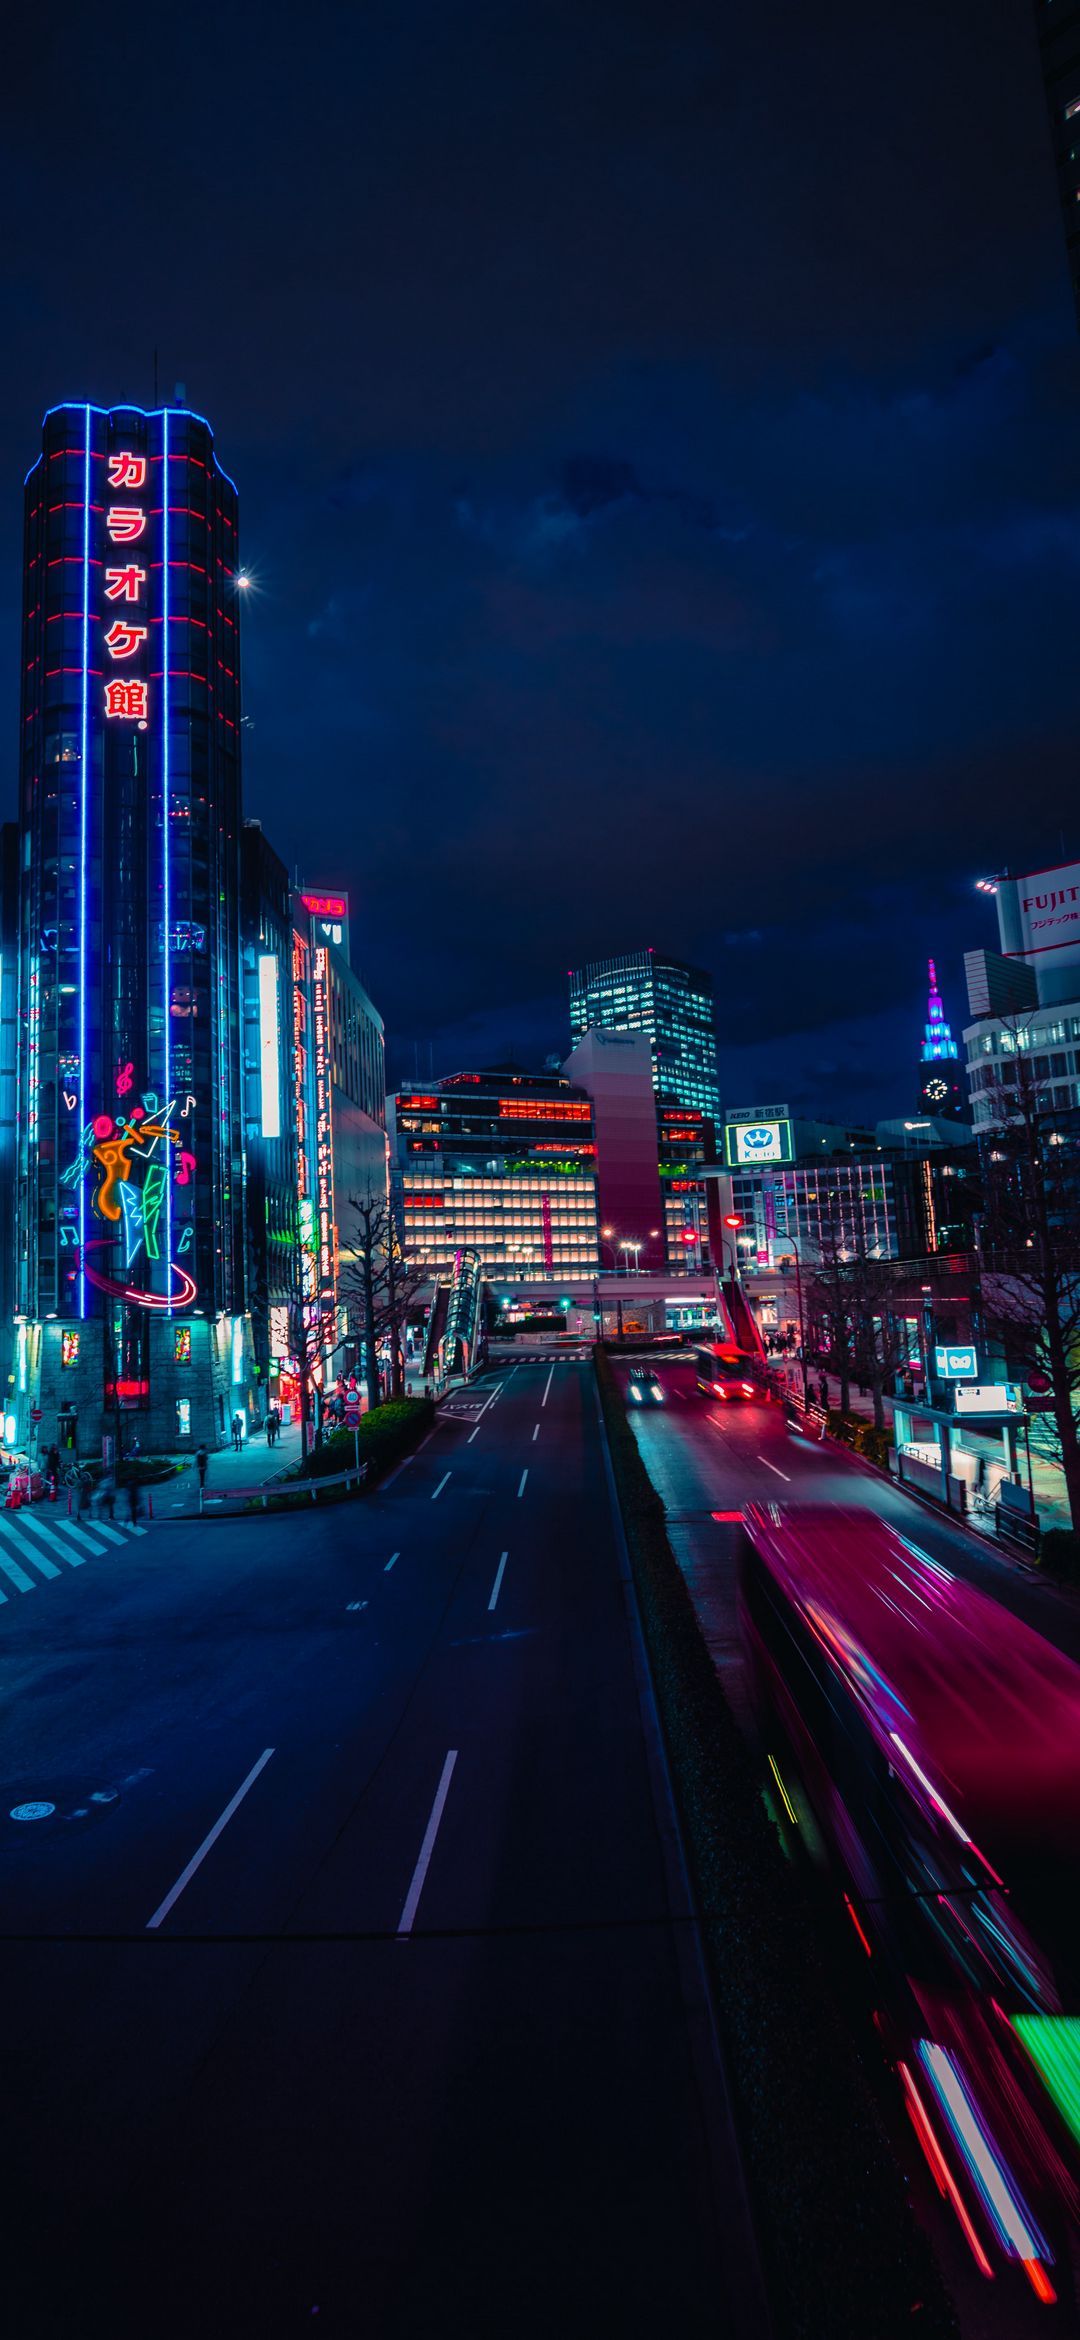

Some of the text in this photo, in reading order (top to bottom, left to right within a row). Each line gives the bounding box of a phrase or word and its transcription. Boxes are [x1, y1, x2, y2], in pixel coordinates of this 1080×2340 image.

[104, 451, 148, 719] カラオケ館
[1022, 886, 1079, 913] FUJIT
[730, 1106, 785, 1119] KEIO 新宿駅
